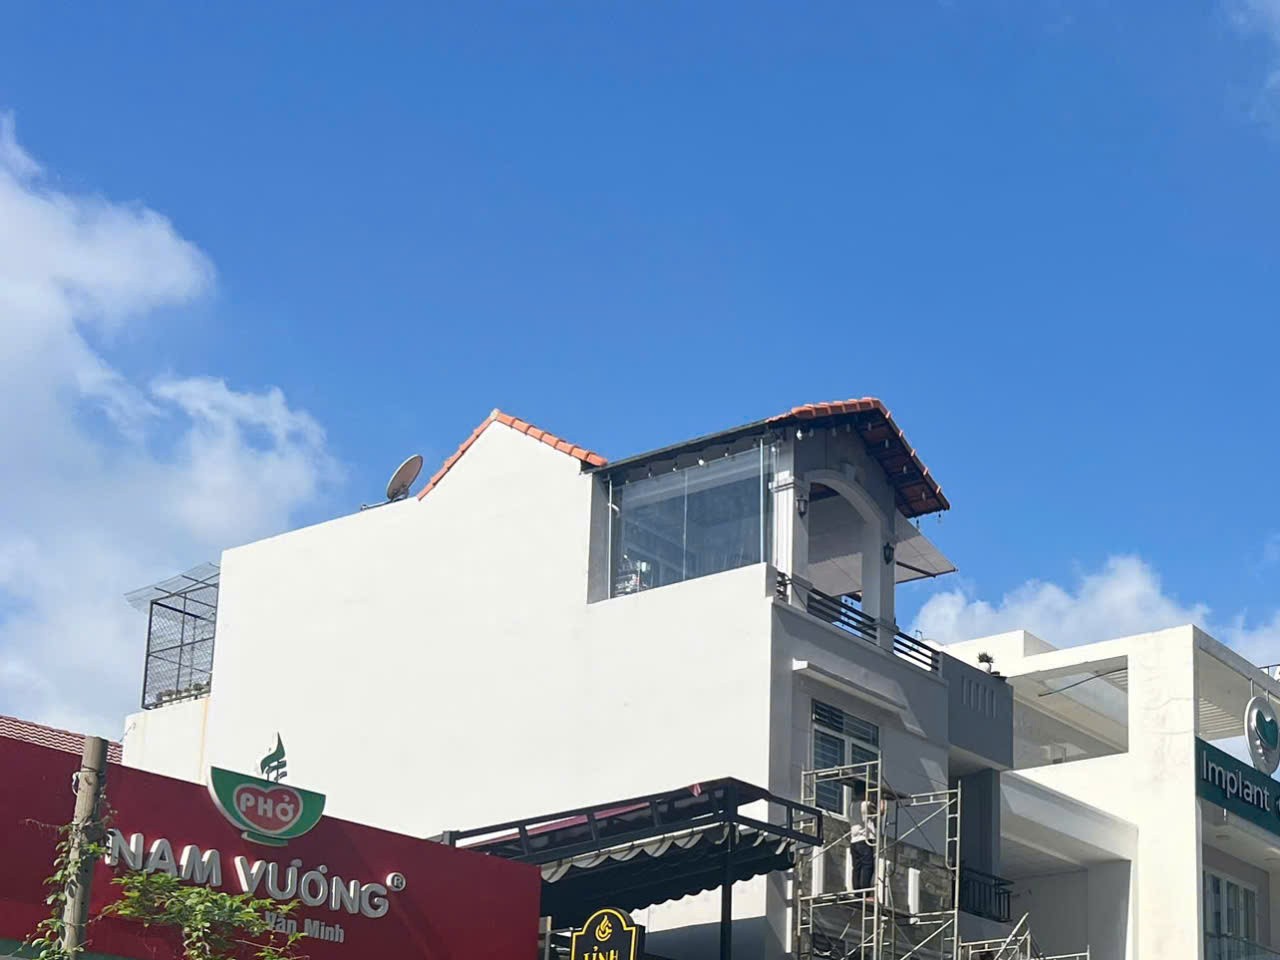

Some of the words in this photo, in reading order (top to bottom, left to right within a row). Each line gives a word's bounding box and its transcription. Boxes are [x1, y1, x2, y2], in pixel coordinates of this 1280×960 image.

[1202, 751, 1271, 812] Implant
[240, 792, 295, 822] PHỞ
[105, 829, 222, 886] NAM
[303, 918, 345, 943] Minh
